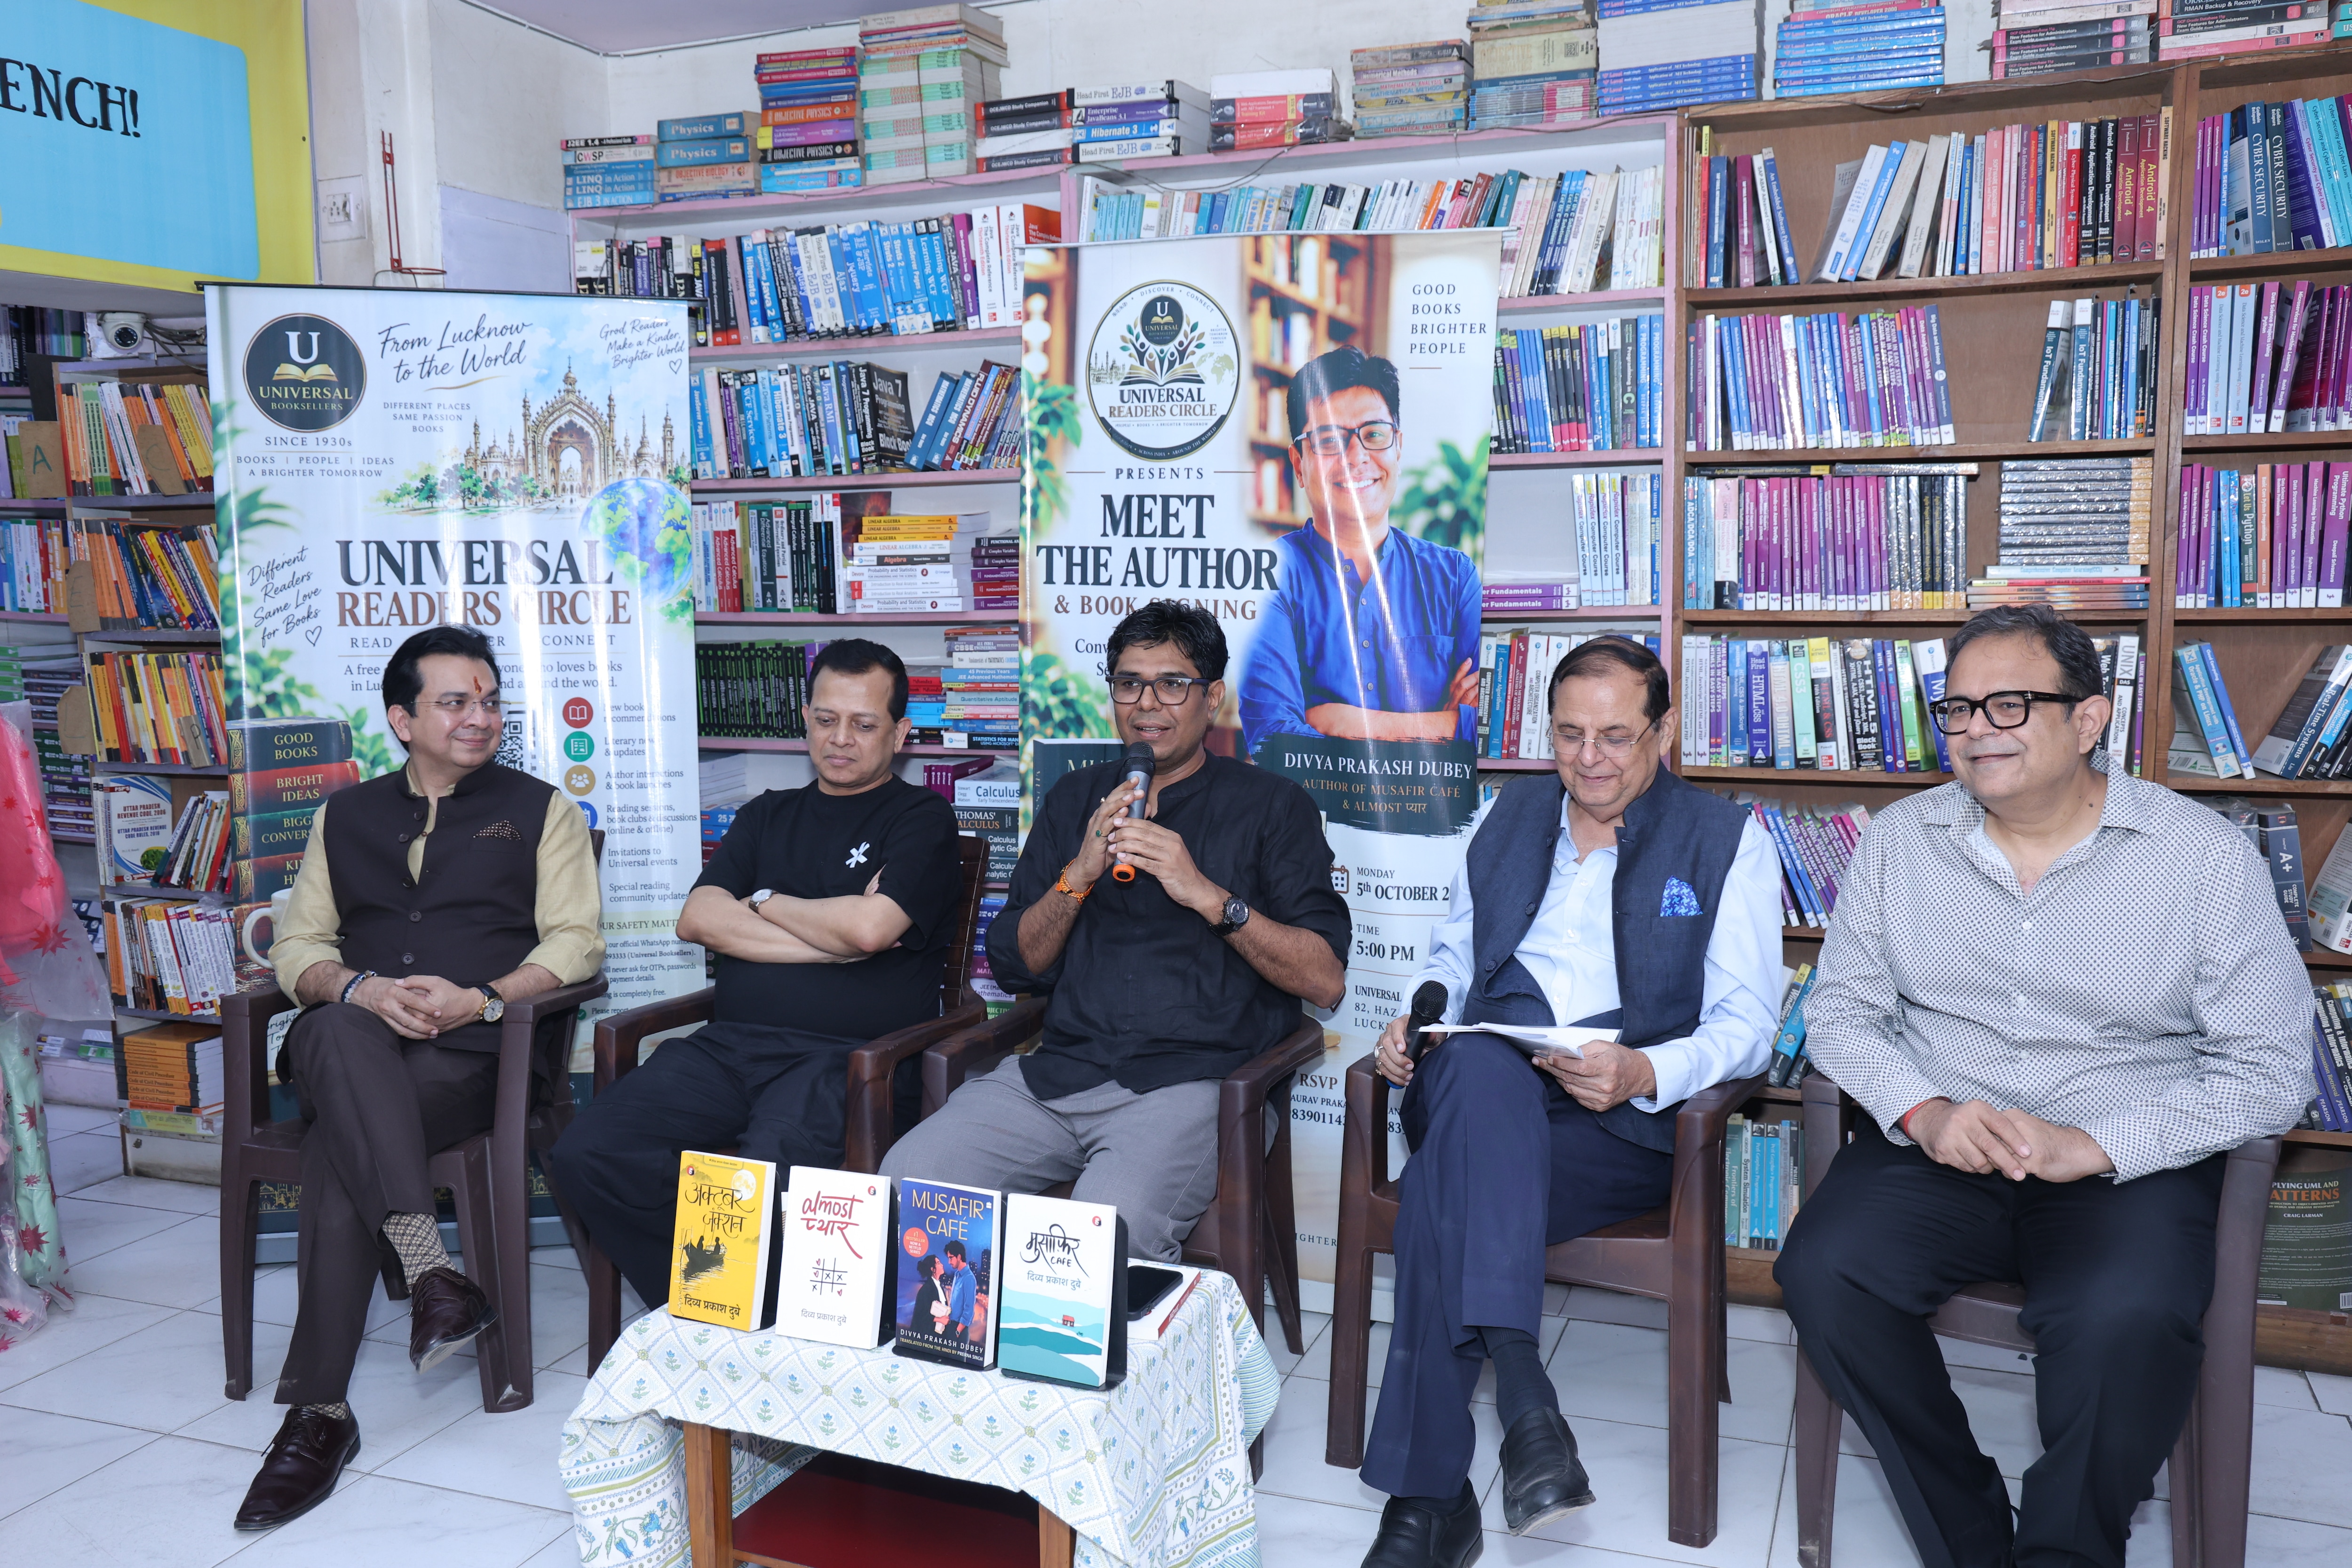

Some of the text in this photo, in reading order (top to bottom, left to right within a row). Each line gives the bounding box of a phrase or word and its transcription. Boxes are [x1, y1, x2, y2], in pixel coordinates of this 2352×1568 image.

[1076, 87, 1132, 100] Head First EJB
[774, 106, 832, 123] OBJECTIVE PHYSICS
[671, 124, 714, 135] Physics
[1091, 126, 1138, 138] Hibernate 3
[576, 175, 602, 184] LINQ
[613, 173, 635, 182] Action
[2252, 133, 2266, 216] CYBER SECURITY
[1412, 284, 1456, 295] GOOD
[1140, 287, 1215, 314] DISCOVER CONNECT
[1411, 303, 1462, 315] BOOKS
[629, 316, 671, 334] Readers
[1411, 323, 1487, 335] BRIGHTER
[378, 313, 533, 359] From Lucknow
[606, 339, 633, 355] Make
[646, 330, 682, 346] Kinder,
[285, 331, 320, 364] U
[611, 340, 685, 369] Brighter World
[1409, 342, 1466, 355] PEOPLE
[393, 339, 527, 383] to the World
[873, 372, 902, 398] Java 7
[259, 386, 353, 400] UNIVERSAL
[1119, 388, 1206, 404] UNIVERSAL
[270, 402, 343, 411] BOOKSELLERS
[383, 402, 433, 410] DIFFERENT
[1109, 404, 1217, 418] READERS CIRCLE
[264, 437, 352, 447] SINCE 1930s
[32, 443, 53, 475] A
[236, 455, 276, 464] BOOKS
[299, 456, 340, 465] PEOPLE
[261, 469, 314, 477] BRIGHTER
[1115, 468, 1204, 480] PRESENTS
[1100, 494, 1215, 539] MEET
[247, 545, 309, 587] Different
[335, 539, 613, 586] UNIVERSAL
[1036, 545, 1280, 591] THE AUTHOR
[260, 570, 313, 603] Readers
[1491, 587, 1543, 596] Fundamentals
[253, 586, 322, 629] Same Love
[1054, 595, 1071, 614] &
[1080, 595, 1137, 617] BOOK
[261, 607, 321, 648] for Books
[350, 637, 393, 648] READ
[542, 635, 617, 646] CONNET
[274, 732, 314, 746] GOOD
[274, 746, 318, 760] BOOKS
[1285, 753, 1472, 780] DIVYA PRAKASH DUBEY
[276, 774, 324, 788] BRIGHT
[1302, 779, 1461, 798] AUTHOR OF MUSAFIR CAFÉ
[282, 788, 320, 803] IDEAS
[976, 786, 1020, 797] Calculus
[1343, 799, 1402, 813] & ALMOST
[1405, 803, 1428, 814] प्यार
[954, 811, 996, 820] THOMAS'
[958, 820, 1000, 829] ALCULUS
[608, 848, 651, 857] Invitations
[608, 859, 648, 868] Universal
[1357, 867, 1395, 879] MONDAY
[609, 881, 670, 893] Special reading
[1357, 881, 1438, 901] 5th OCTOBER
[610, 892, 690, 903] community updates
[617, 919, 680, 930] SAFETY MATT
[1356, 923, 1380, 936] TIME
[1356, 940, 1415, 961] 5:00 PM
[1355, 985, 1402, 1002] UNIVERSAL
[1299, 1073, 1337, 1090] RSVP
[1292, 1108, 1345, 1125] 8390114
[2319, 1098, 2331, 1122] PEARSON
[2272, 1181, 2303, 1189] PLYING
[685, 1182, 755, 1213] अक्टूबर
[2270, 1188, 2340, 1202] ATTERNS
[802, 1190, 864, 1219] almost
[912, 1189, 985, 1220] MUSAFIR
[703, 1208, 747, 1238] जंक्शन
[926, 1215, 968, 1241] CAFÉ
[800, 1218, 863, 1259] प्यार
[1050, 1256, 1072, 1267] CAFE
[1027, 1271, 1081, 1292] दिव्य प्रकाश दुबे
[684, 1294, 740, 1319] दिव्य प्रकाश दुबे
[801, 1308, 847, 1325] दिव्य प्रकाश दुबे
[900, 1329, 983, 1353] DIVYA PRAKASH DUBEY
